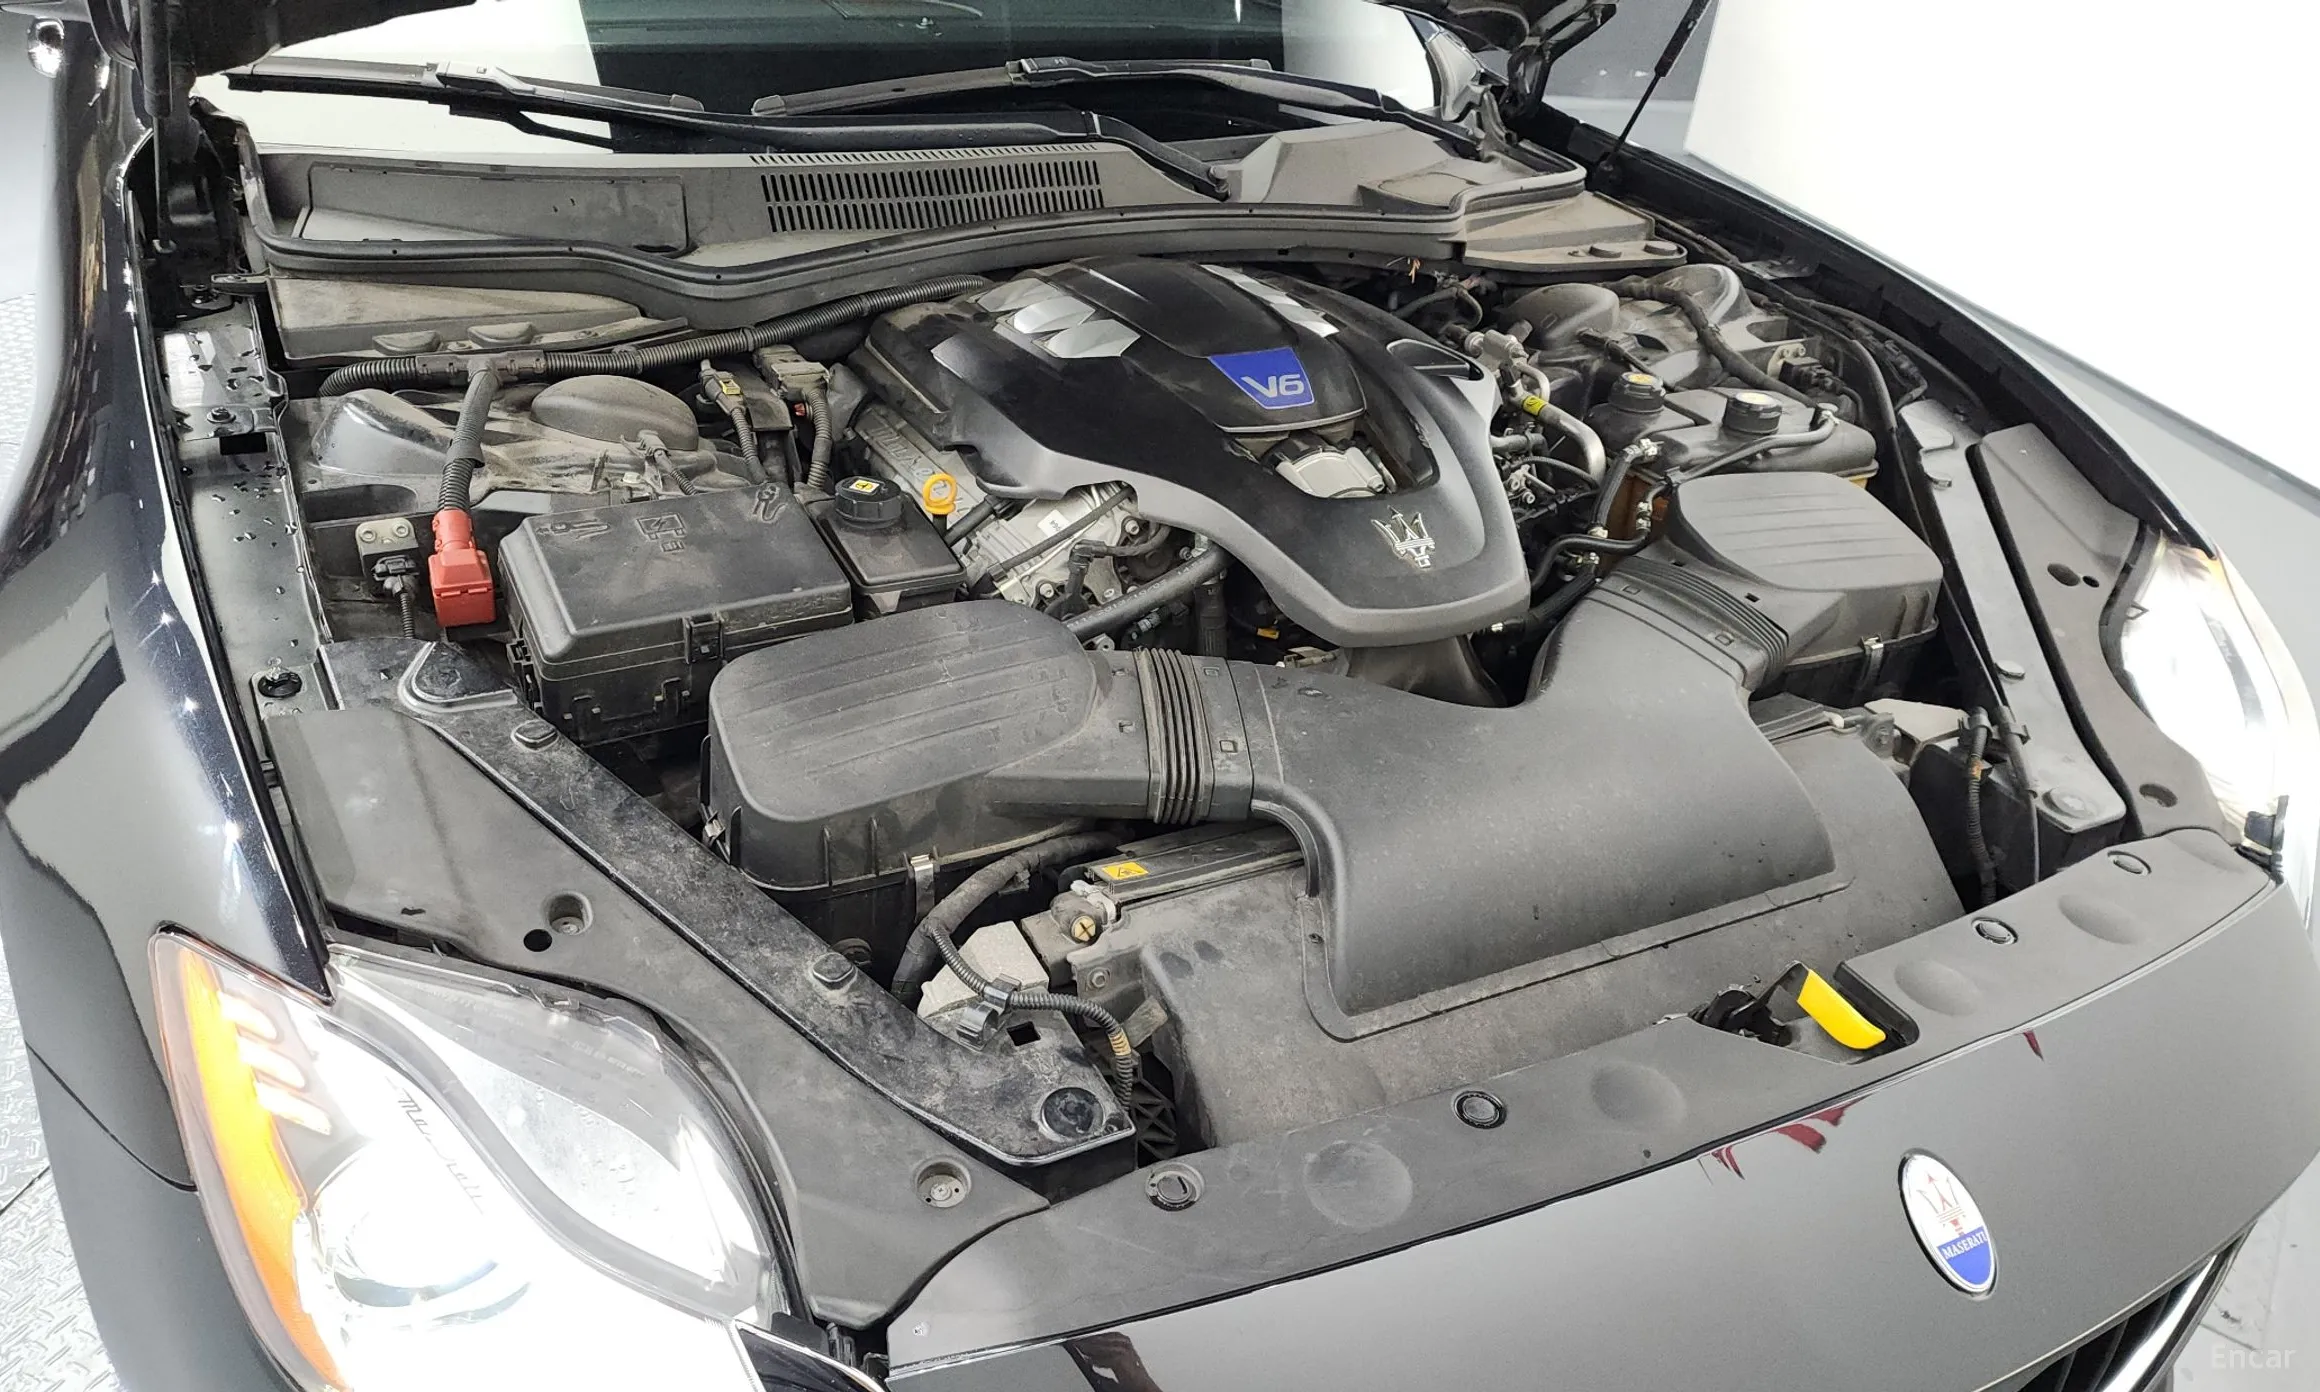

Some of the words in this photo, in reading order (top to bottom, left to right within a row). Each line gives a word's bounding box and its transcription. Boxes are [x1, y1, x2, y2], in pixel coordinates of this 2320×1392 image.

[1240, 373, 1305, 398] V6
[396, 1086, 485, 1215] Marati
[1941, 1231, 1988, 1260] MASERATI
